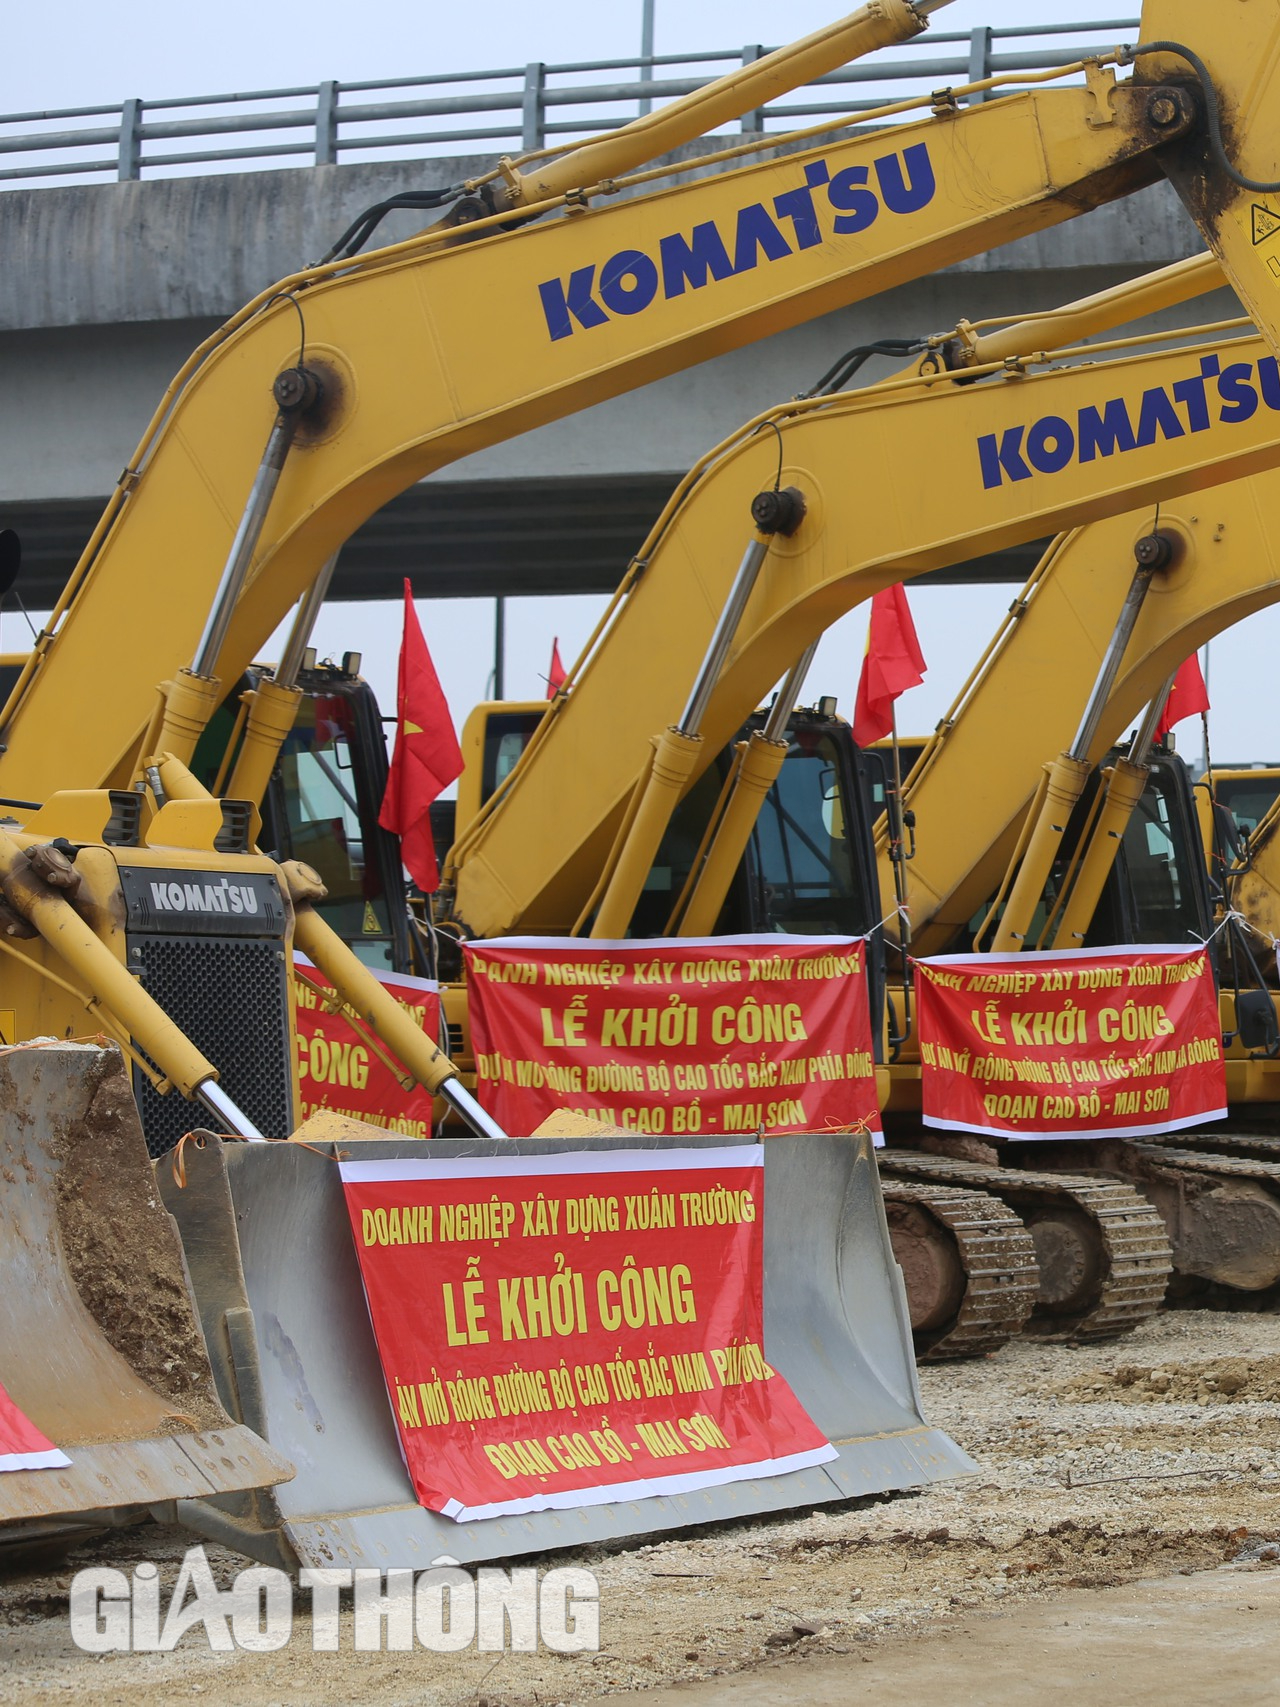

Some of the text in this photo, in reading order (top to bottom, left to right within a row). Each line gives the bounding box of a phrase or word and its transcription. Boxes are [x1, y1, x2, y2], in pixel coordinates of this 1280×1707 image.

[538, 142, 937, 342] KOMATSU
[150, 878, 258, 914] KOMATSU
[543, 959, 625, 990] NGHIỆP
[633, 958, 676, 984] XÂY
[681, 958, 742, 988] DỰNG
[747, 954, 795, 982] XUÂN
[966, 971, 1037, 997] NGHIỆP
[1040, 968, 1073, 991] XÂY
[1078, 968, 1122, 992] DỰNG
[1127, 962, 1162, 986] XUÂN
[540, 993, 808, 1047] LỄ KHỞI CÔNG
[971, 999, 1175, 1046] LỄ KHỞI CÔNG
[587, 1059, 644, 1093] ĐƯỜNG
[646, 1060, 671, 1097] BỘ
[673, 1064, 708, 1091] CAO
[710, 1054, 744, 1090] TỐC
[747, 1052, 779, 1088] BẮC
[808, 1050, 845, 1083] PHÍA
[846, 1048, 874, 1079] ĐÔNG
[972, 1052, 1014, 1085] RỘNG
[1052, 1057, 1072, 1088] BỘ
[1072, 1060, 1100, 1083] CAO
[1100, 1051, 1129, 1081] TỐC
[1154, 1050, 1176, 1075] NAM
[1187, 1036, 1219, 1065] ĐÔNG
[622, 1107, 666, 1133] CAO
[672, 1097, 702, 1133] BỒ
[723, 1103, 762, 1131] MAI
[766, 1098, 808, 1128] SƠN
[984, 1095, 1038, 1123] ĐOẠN
[1042, 1094, 1075, 1119] CAO
[1078, 1086, 1100, 1118] BỒ
[1113, 1090, 1141, 1115] MAI
[1143, 1086, 1169, 1112] SƠN
[362, 1183, 756, 1248] DOANH NGHIỆP XÂY DỰNG XUÂN TRƯỜNG
[442, 1252, 697, 1347] LỄ KHỞI CÔNG
[418, 1367, 450, 1427] MỞ
[445, 1370, 497, 1431] RỘNG
[493, 1362, 551, 1417] ĐƯỜNG
[549, 1360, 576, 1418] BỘ
[577, 1365, 609, 1406] CAO
[607, 1350, 641, 1403] TỐC
[641, 1341, 674, 1400] BẮC
[671, 1352, 714, 1394] NAM
[483, 1432, 556, 1483] ĐOẠN
[552, 1431, 600, 1471] CAO
[597, 1420, 631, 1464] BỒ
[637, 1423, 686, 1459] MAI
[688, 1414, 731, 1452] SƠN
